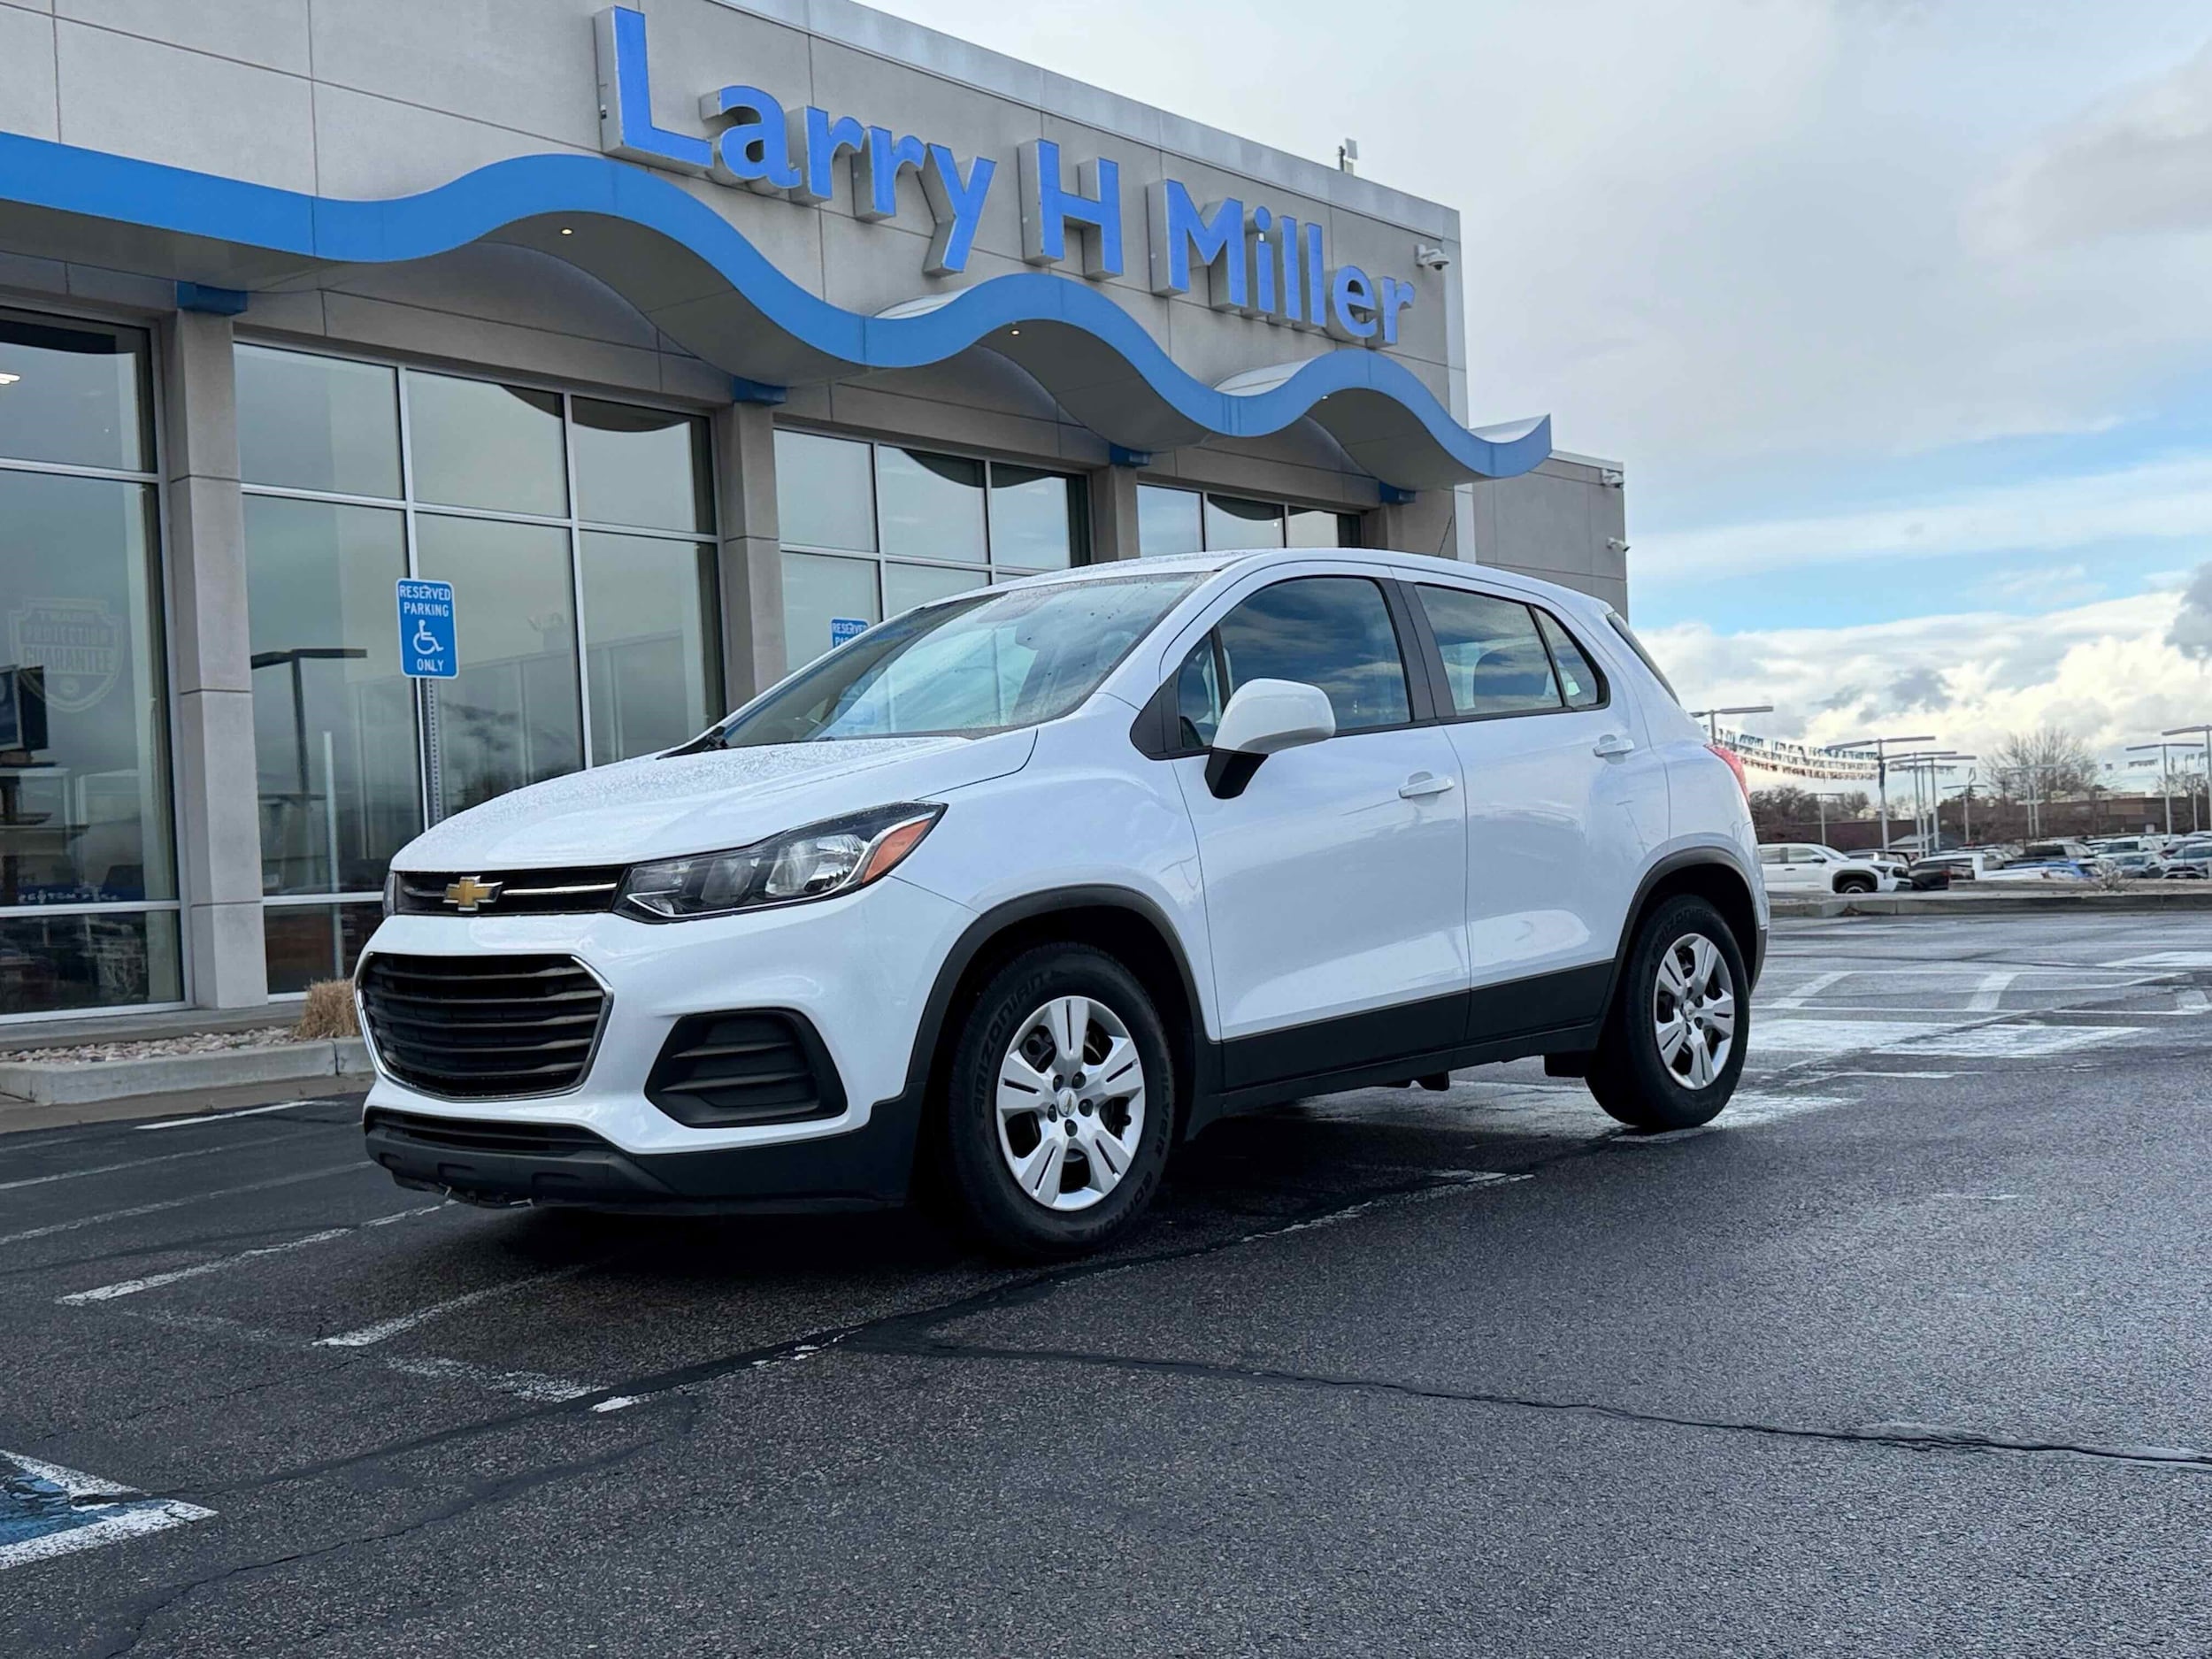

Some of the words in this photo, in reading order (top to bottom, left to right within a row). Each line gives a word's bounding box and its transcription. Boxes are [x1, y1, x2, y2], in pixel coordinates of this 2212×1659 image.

[597, 6, 996, 276] Larry
[1022, 139, 1123, 280] H
[1148, 179, 1414, 347] Miller
[399, 585, 451, 601] RESERVED
[403, 602, 449, 617] PARKING
[417, 658, 444, 672] ONLY
